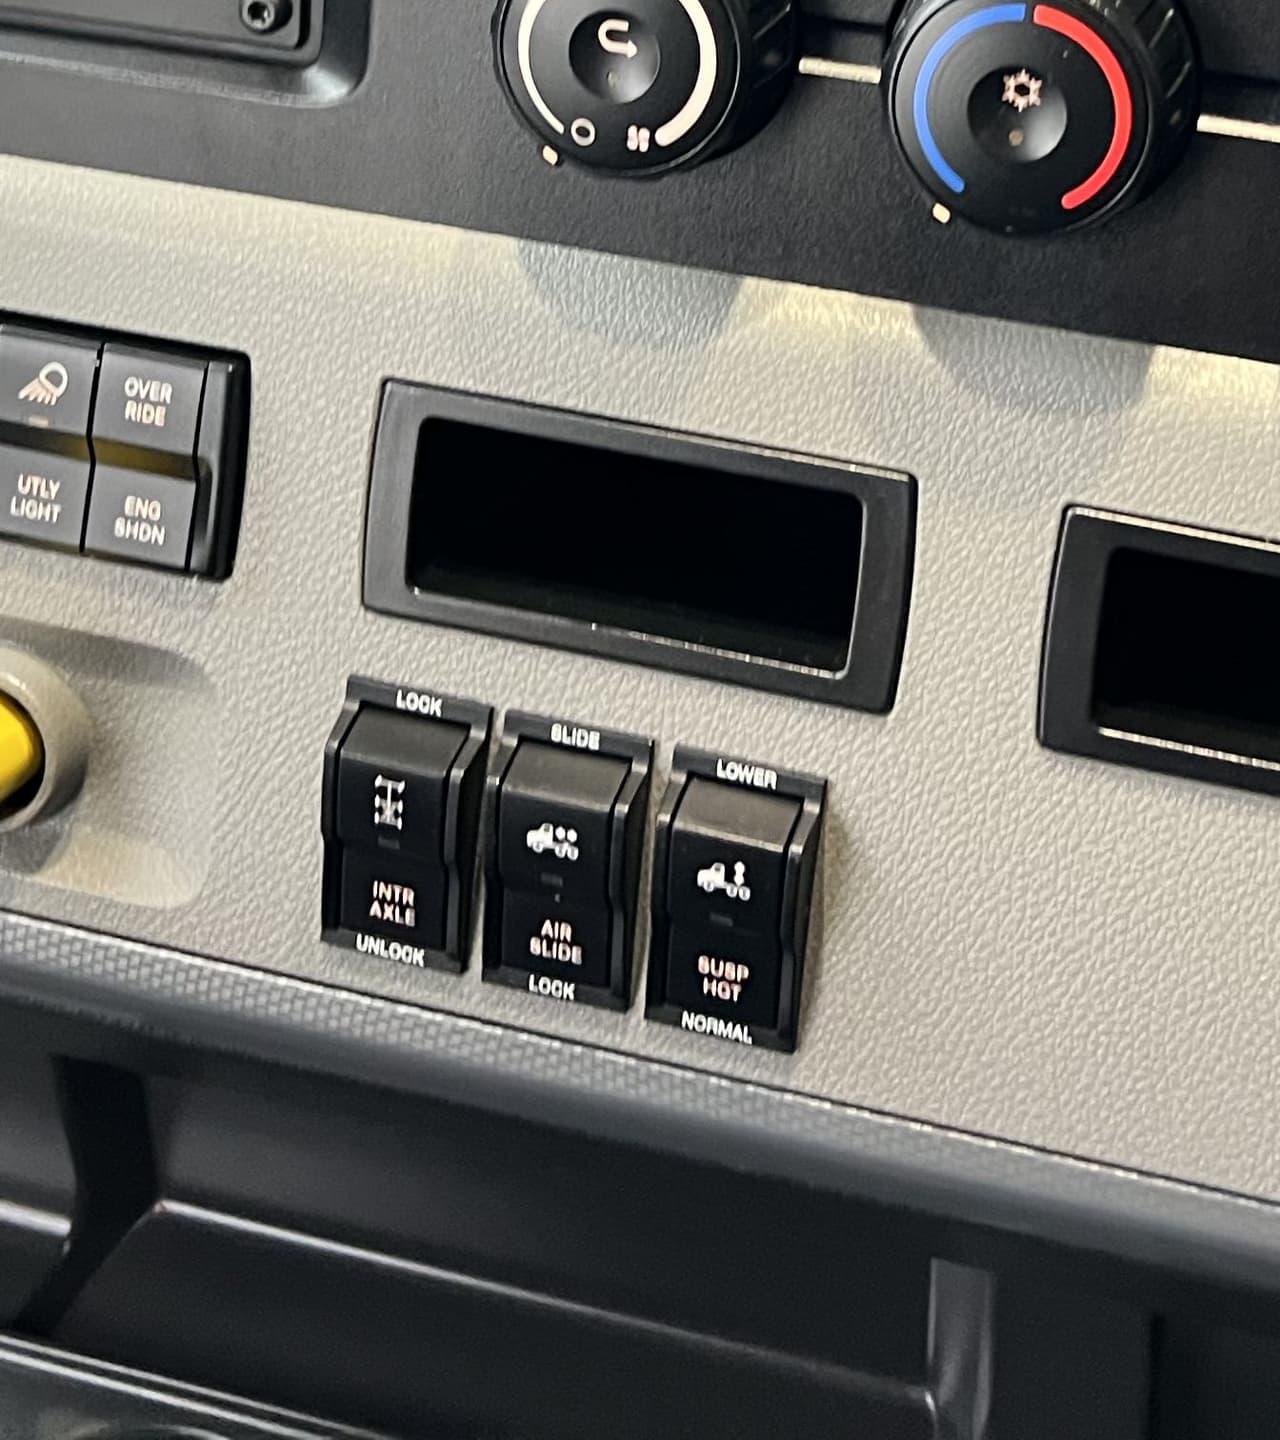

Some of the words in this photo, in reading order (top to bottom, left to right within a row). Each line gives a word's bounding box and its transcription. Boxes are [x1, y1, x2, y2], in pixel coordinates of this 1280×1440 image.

[123, 376, 173, 406] OVER
[123, 399, 166, 428] RIDE
[17, 473, 61, 500] UTLY
[9, 495, 63, 524] LIGHT
[396, 688, 442, 717] LOCK
[550, 722, 601, 752] SLIDE
[715, 757, 779, 790] LOWER
[372, 879, 416, 907] INTR
[369, 900, 416, 928] AXLE
[540, 918, 573, 943] AIR
[356, 932, 426, 968] UNLOCK
[529, 935, 583, 966] SLIDE
[528, 972, 576, 1001] LOCK
[681, 1009, 753, 1046] NORMAL
